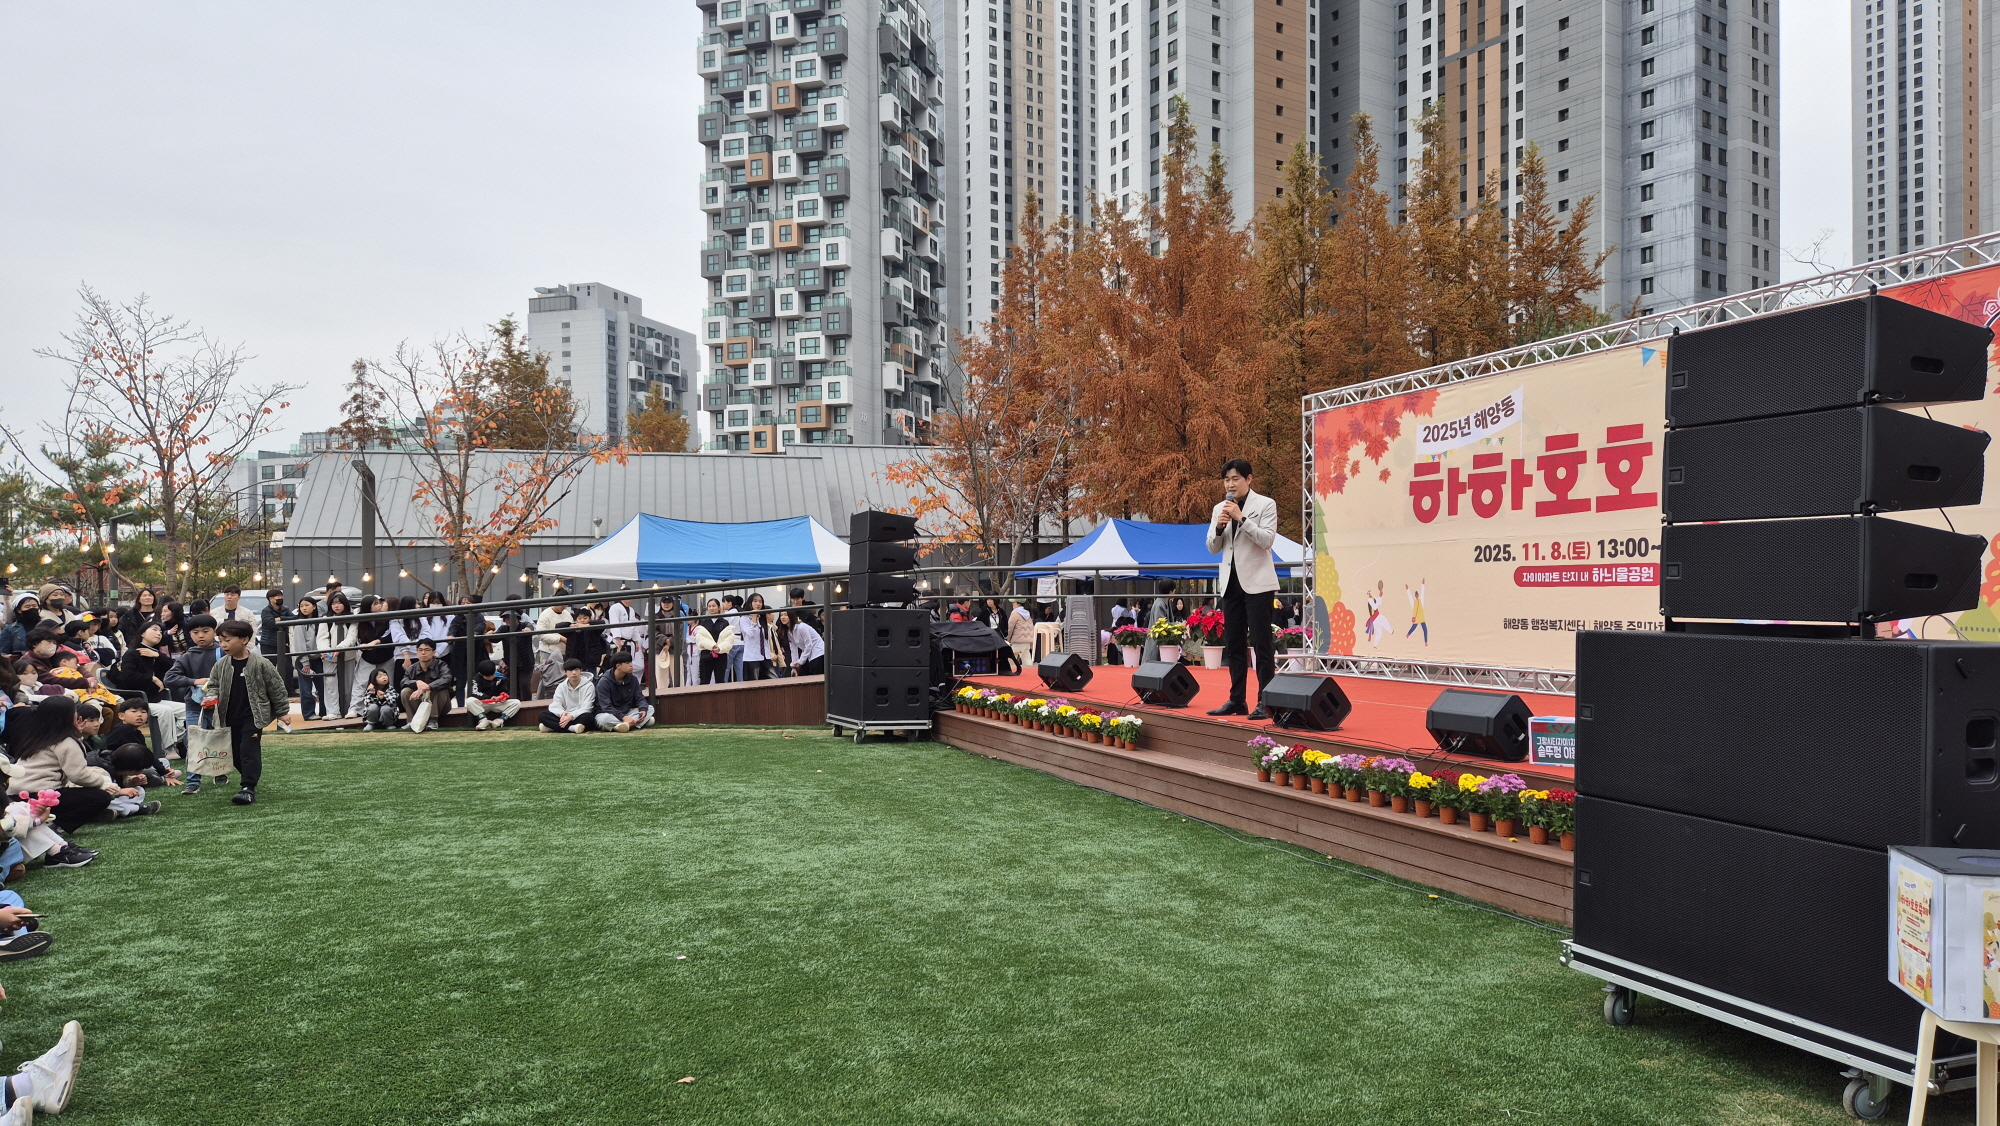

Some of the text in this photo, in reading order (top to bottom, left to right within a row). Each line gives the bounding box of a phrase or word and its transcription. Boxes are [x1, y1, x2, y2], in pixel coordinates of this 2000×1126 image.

[1422, 395, 1516, 443] 2025년 해양동
[1474, 544, 1517, 563] 2025.
[1522, 566, 1654, 583] 자이아파트 단지 내 하늬울공원
[1503, 618, 1529, 631] 해양동
[1531, 618, 1586, 632] 행정복지센터
[1538, 745, 1561, 758] 솥뚜껑
